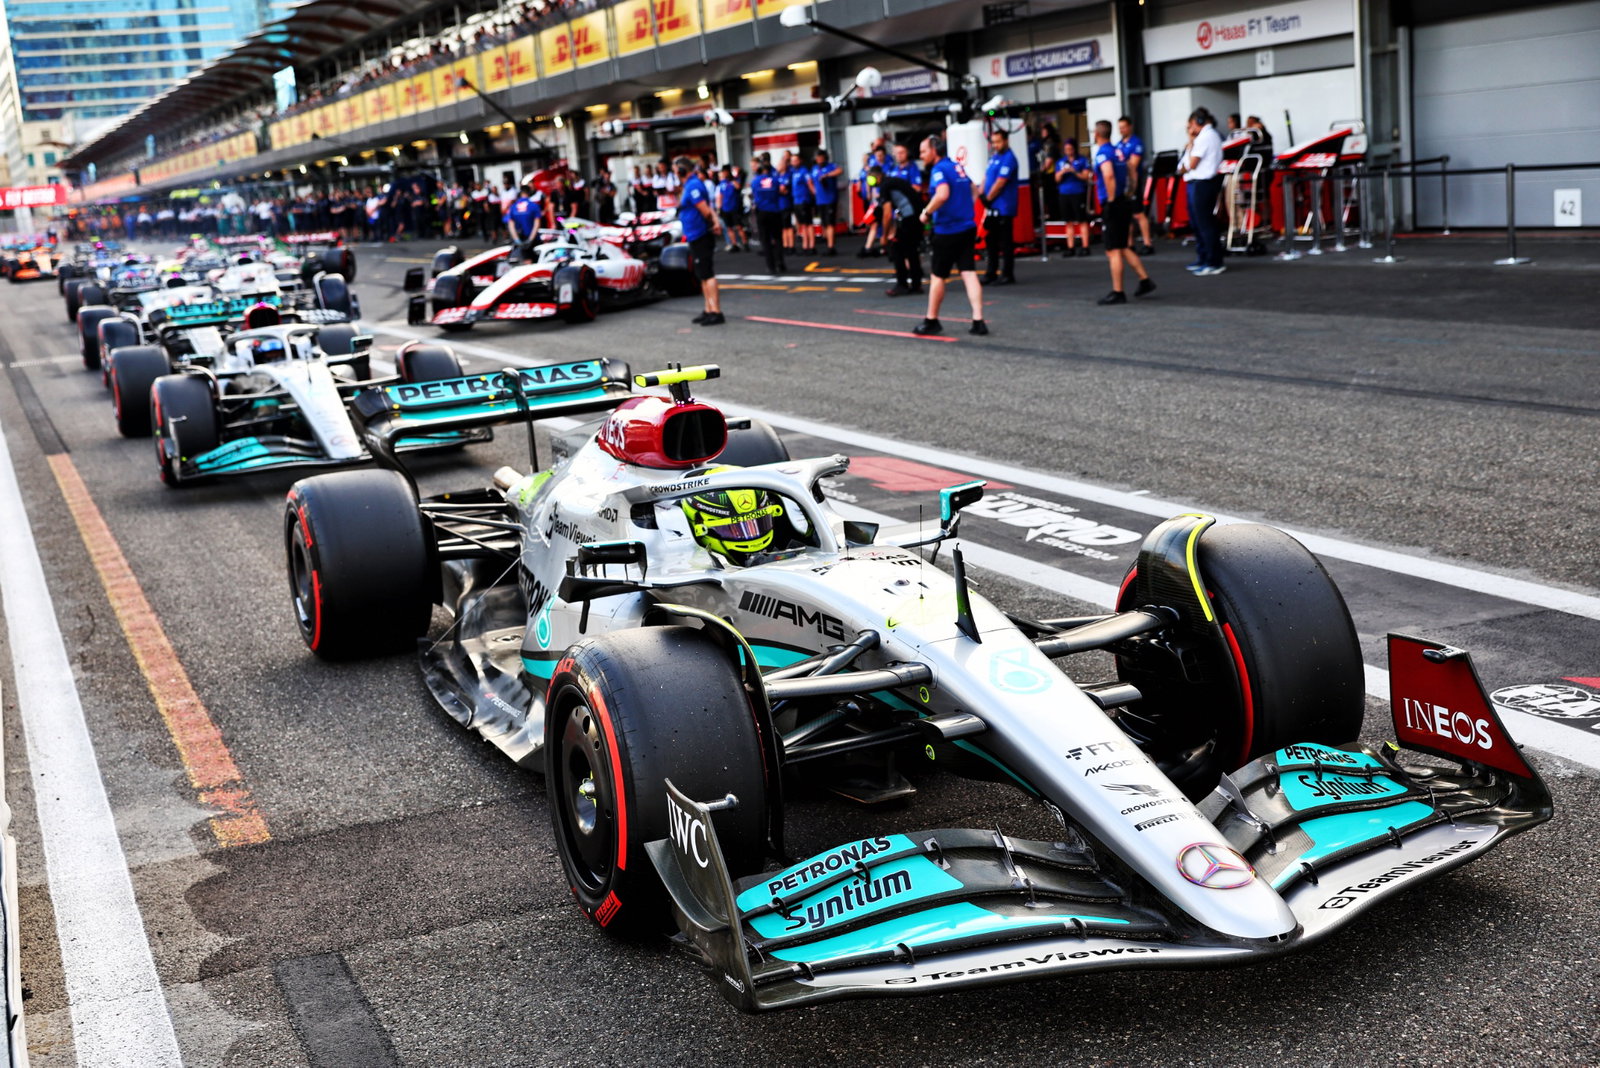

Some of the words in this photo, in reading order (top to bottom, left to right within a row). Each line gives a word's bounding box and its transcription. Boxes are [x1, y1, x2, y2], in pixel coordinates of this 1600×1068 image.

[556, 26, 594, 62] DHL
[1214, 24, 1247, 42] Haas
[1248, 20, 1262, 35] F1
[1264, 15, 1300, 33] Team
[1560, 200, 1576, 216] 42
[649, 477, 710, 494] CROWDSTRIKE
[551, 514, 597, 545] TeamViewe
[730, 508, 769, 523] PETRONAS
[772, 599, 846, 642] AMG
[1402, 697, 1494, 750] INEOS
[1085, 740, 1123, 756] FT
[1283, 745, 1358, 765] PETRONAS
[1084, 757, 1150, 777] AKKOD
[1297, 774, 1392, 801] Syntium
[665, 792, 710, 869] IWC
[767, 835, 893, 896] PETRONAS
[1337, 839, 1479, 894] TeamViewer
[785, 869, 913, 931] Syntium
[921, 945, 1164, 981] TeamViewer
